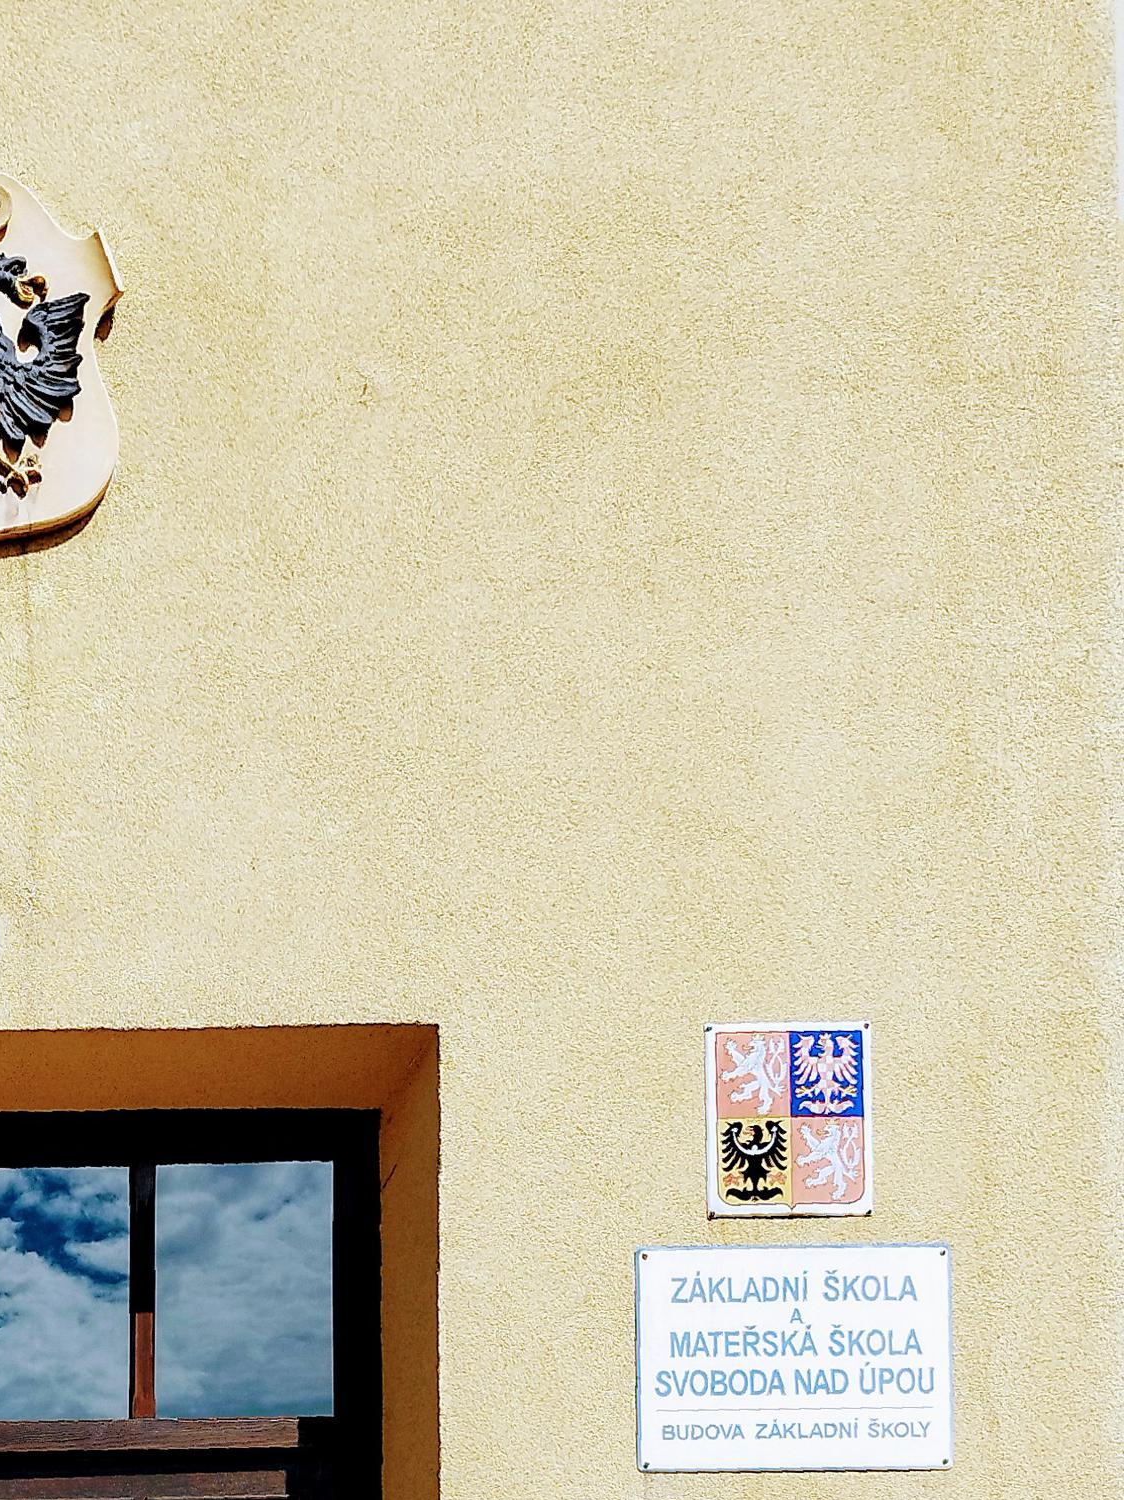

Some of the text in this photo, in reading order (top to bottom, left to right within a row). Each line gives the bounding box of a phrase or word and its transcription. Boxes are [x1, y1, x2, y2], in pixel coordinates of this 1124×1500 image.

[671, 1270, 918, 1303] ZÁKLADNÍ ŠKOLA
[789, 1308, 804, 1324] A
[669, 1324, 923, 1358] MATEŘSKÁ ŠKOLA
[654, 1361, 935, 1397] SVOBODA NAD ÚPOU
[661, 1418, 931, 1441] BUDOVA ZÁKLADNÍ ŠKOLY
